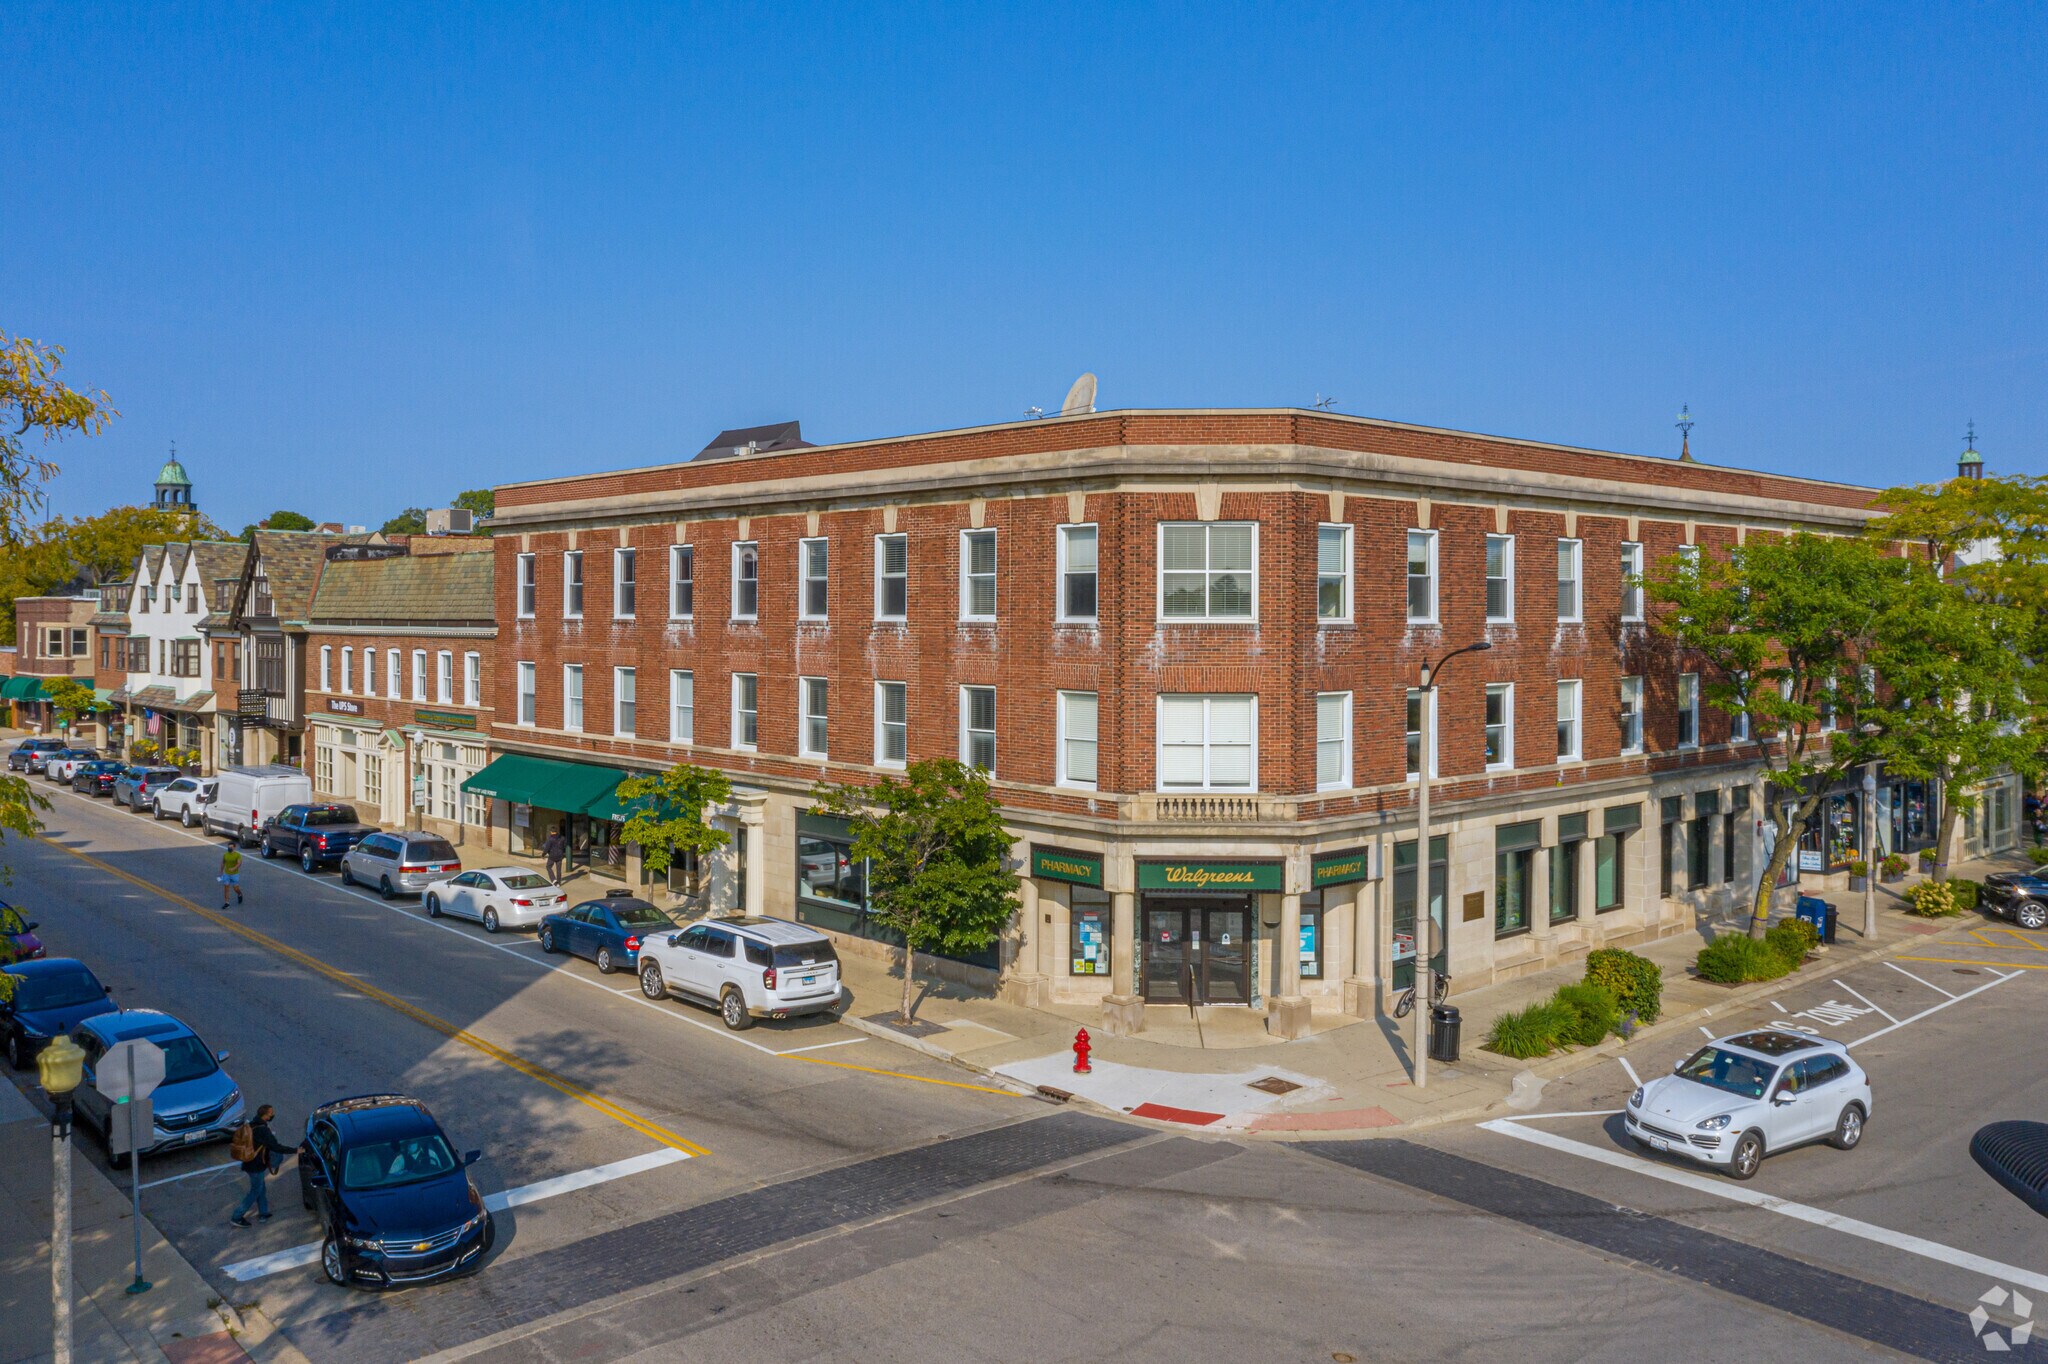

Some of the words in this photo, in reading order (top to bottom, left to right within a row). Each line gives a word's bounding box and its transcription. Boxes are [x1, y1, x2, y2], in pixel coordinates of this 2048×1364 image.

[1040, 859, 1092, 877] PHARMACY
[1165, 866, 1255, 887] Walgreens
[1317, 861, 1361, 879] PHARMACY
[1791, 1000, 1875, 1026] ZONE
